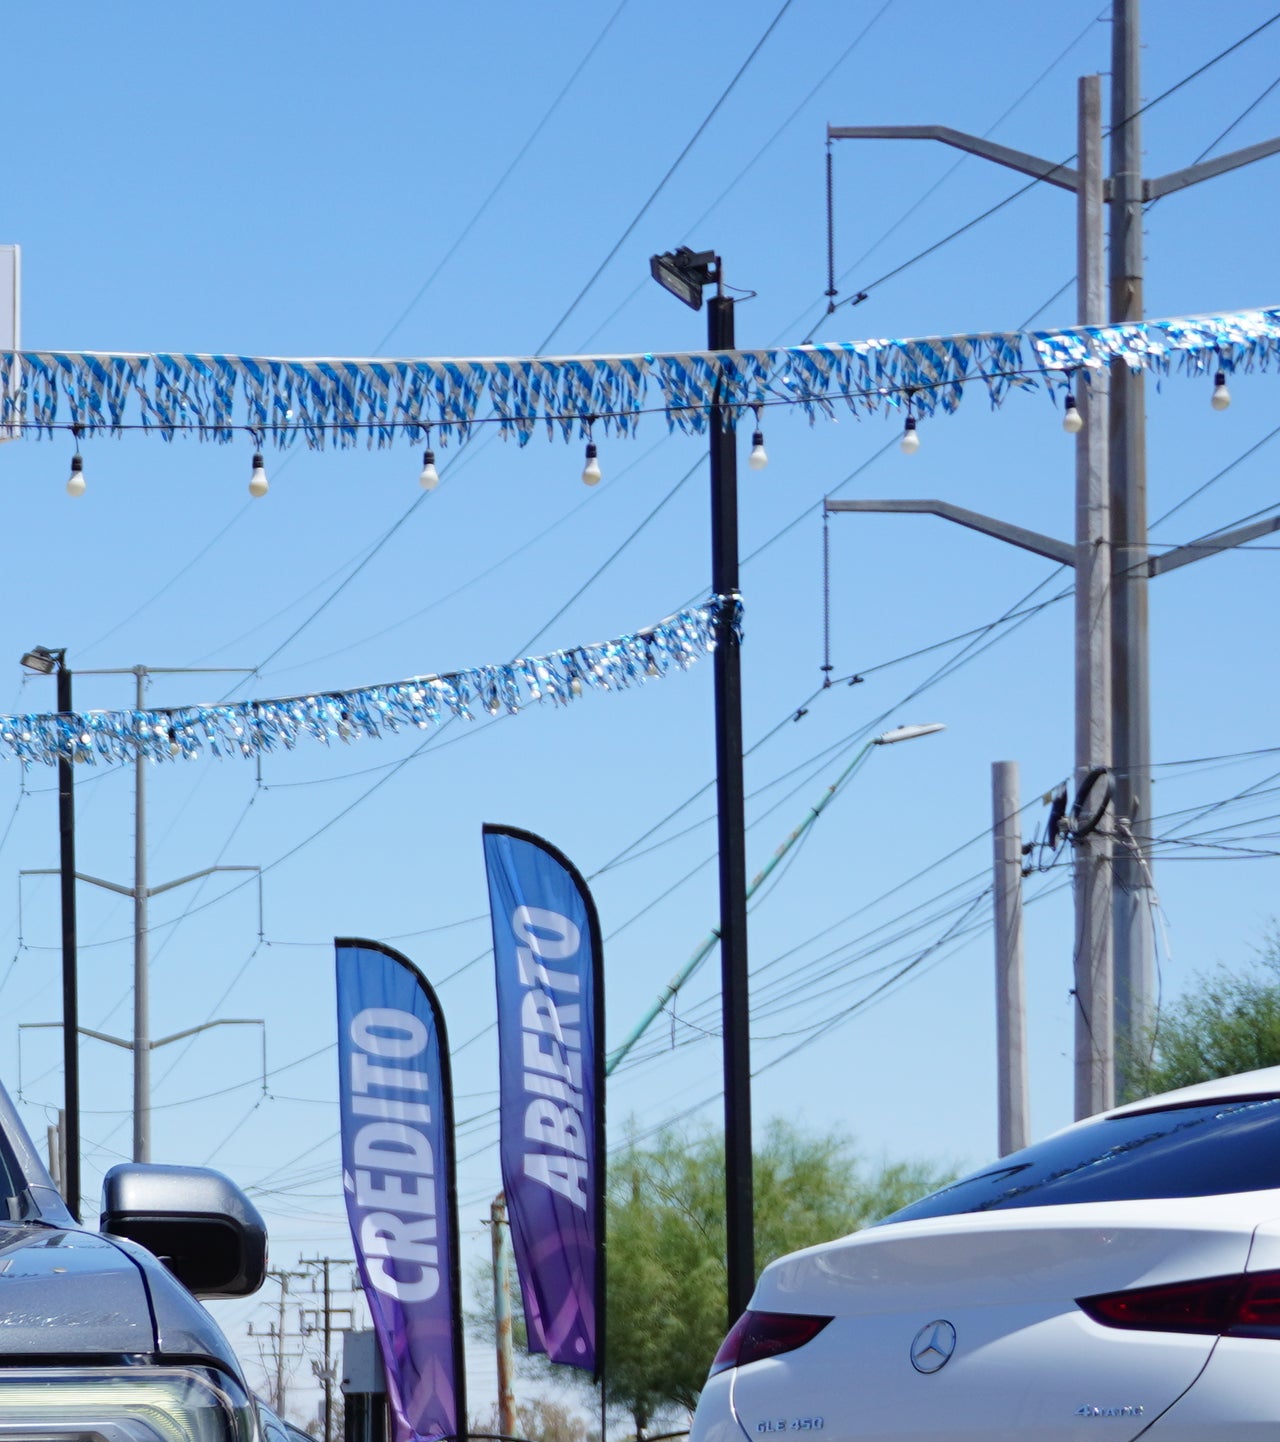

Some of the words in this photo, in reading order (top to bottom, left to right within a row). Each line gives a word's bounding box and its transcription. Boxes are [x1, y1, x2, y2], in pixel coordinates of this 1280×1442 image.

[343, 1007, 440, 1304] CRÉDITO
[512, 904, 588, 1212] ABIERTO
[757, 1418, 787, 1433] GLE
[790, 1416, 824, 1431] 450
